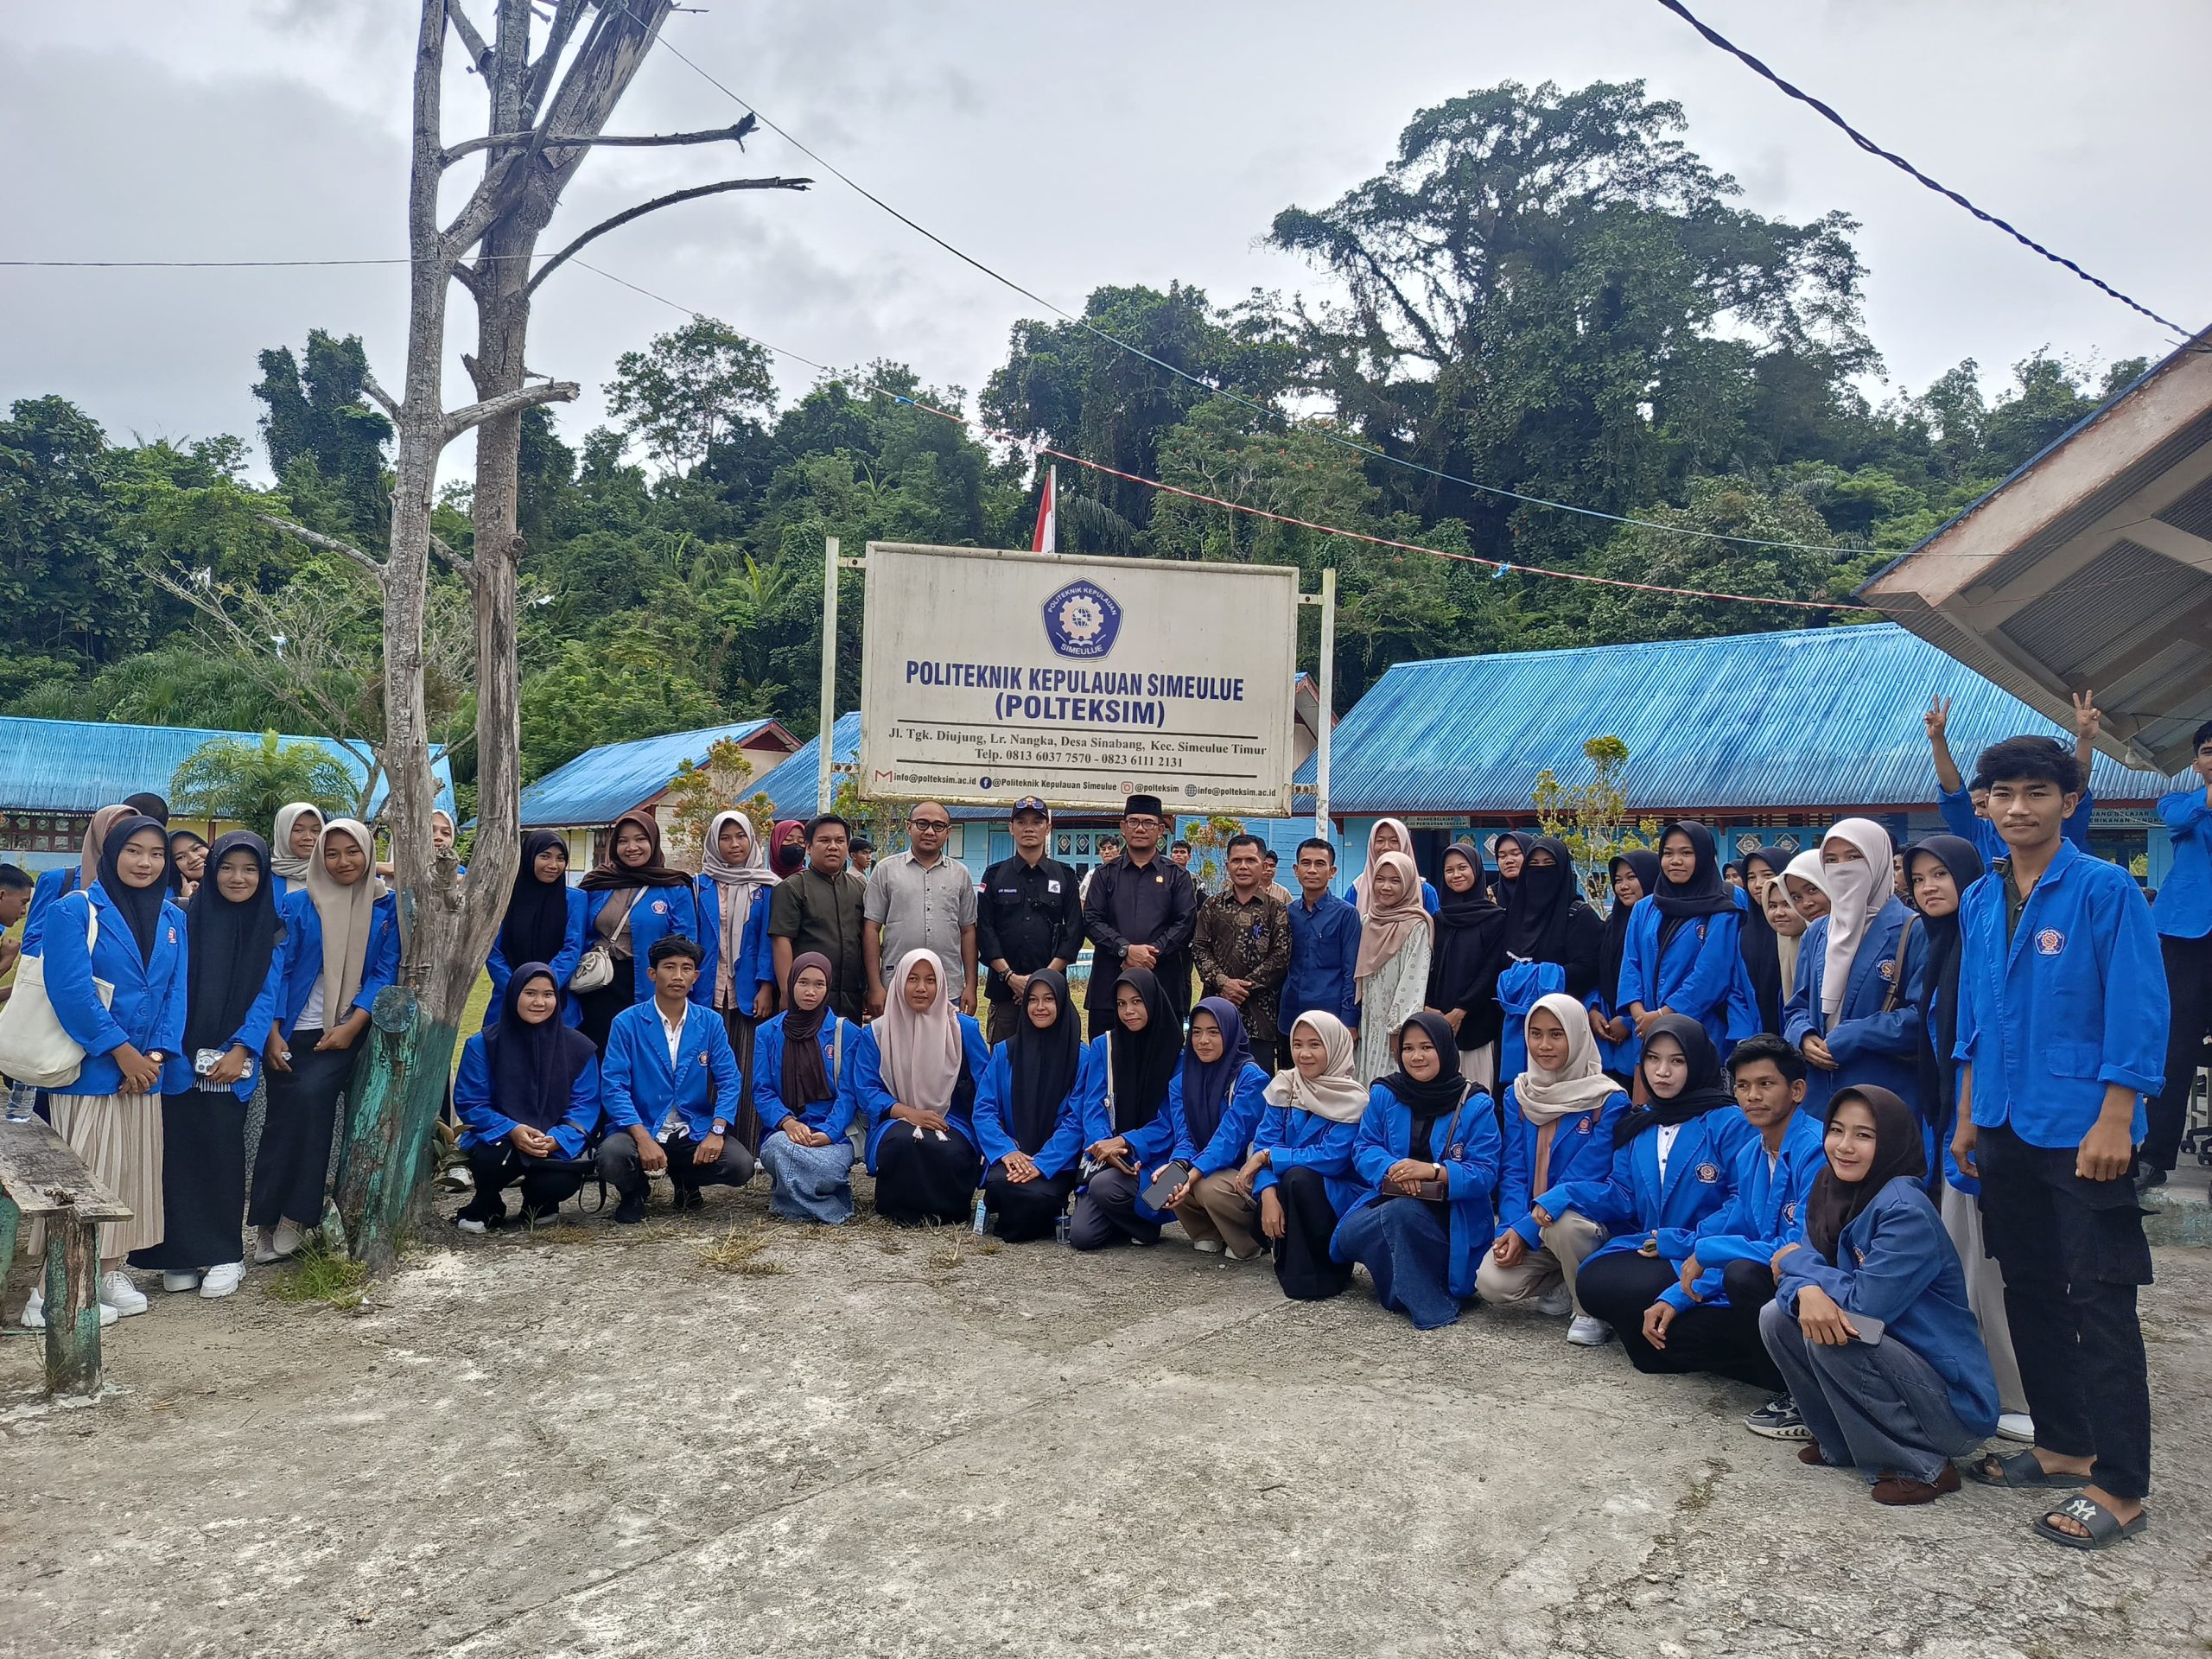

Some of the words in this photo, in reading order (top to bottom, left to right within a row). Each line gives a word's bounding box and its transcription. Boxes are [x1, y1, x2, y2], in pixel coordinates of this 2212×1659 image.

[1047, 587, 1082, 613] POLITEKNIK
[1083, 588, 1118, 615] KEPULAUAN
[1060, 643, 1103, 655] SIMEULUE
[906, 660, 1023, 690] POLITEKNIK
[1029, 667, 1142, 696] KEPULAUAN
[1147, 673, 1244, 702] SIMEULUE
[995, 691, 1166, 728] (POLTEKSIM)
[888, 728, 903, 739] Jl.
[906, 728, 932, 742] Tgk.
[937, 730, 987, 745] Diujung,
[990, 734, 1007, 744] Lr.
[1010, 734, 1058, 747] Nangka,
[1061, 736, 1087, 747] Desa
[1090, 738, 1146, 752] Sinabang,
[1151, 741, 1174, 752] Kec.
[1178, 741, 1229, 753] Simeulue
[1231, 744, 1268, 755] Timur
[975, 748, 1002, 761] Telp.
[1006, 750, 1033, 761] 0813
[1035, 752, 1062, 762] 6037
[1066, 753, 1091, 764] 7570
[1102, 754, 1128, 765] 0823
[1130, 755, 1154, 766] 6111
[1158, 756, 1183, 767] 2131
[893, 772, 976, 785] info@polteksim.ac.id
[992, 778, 1039, 788] @Politeknik
[1041, 779, 1080, 790] Kepulauan
[1083, 781, 1117, 791] Simeulue
[1135, 783, 1179, 793] @polteksim
[1198, 785, 1276, 798] info@polteksim.ac.id
